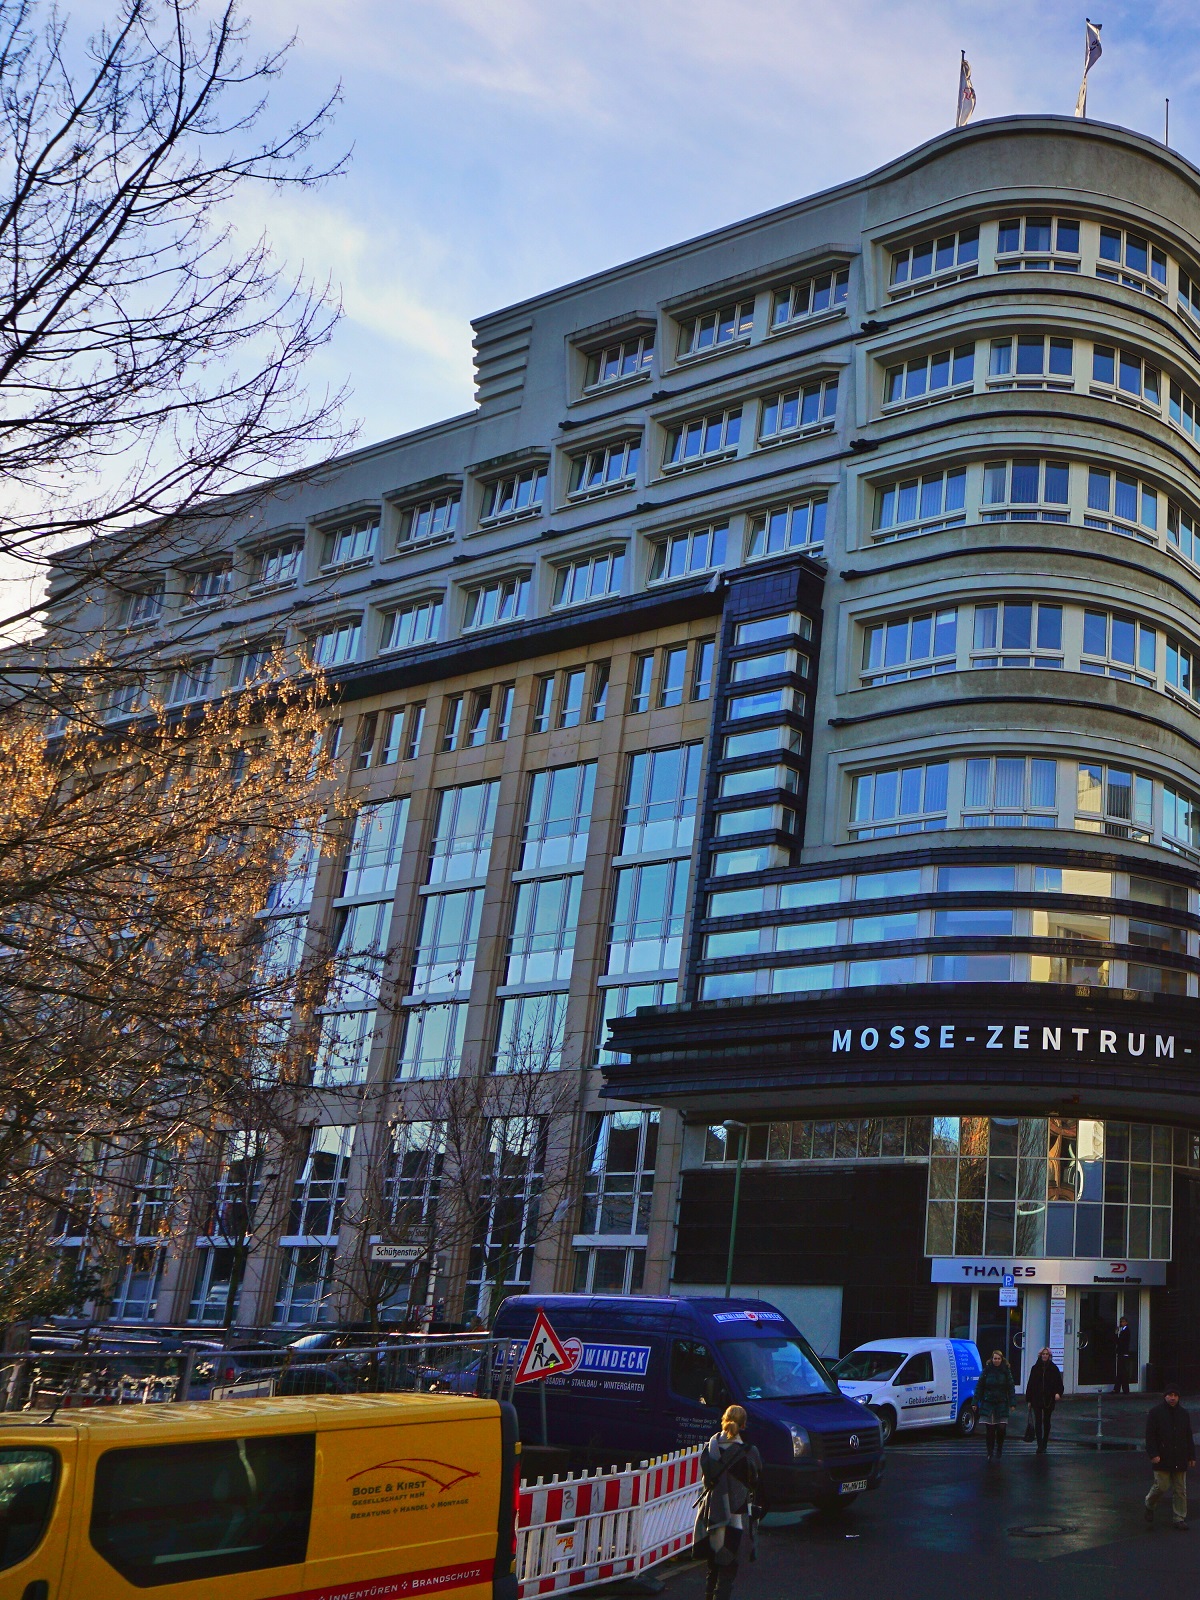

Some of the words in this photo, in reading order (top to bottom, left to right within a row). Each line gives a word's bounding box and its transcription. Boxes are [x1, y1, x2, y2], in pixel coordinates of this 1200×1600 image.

[962, 1266, 1036, 1276] THALES
[1054, 1287, 1064, 1296] 25
[585, 1348, 646, 1370] WINDECK
[571, 1379, 598, 1388] STAHLBAU
[603, 1380, 645, 1392] WINTERGÄRTEN
[385, 1483, 393, 1492] &
[352, 1494, 407, 1506] GESELLSCHAFT
